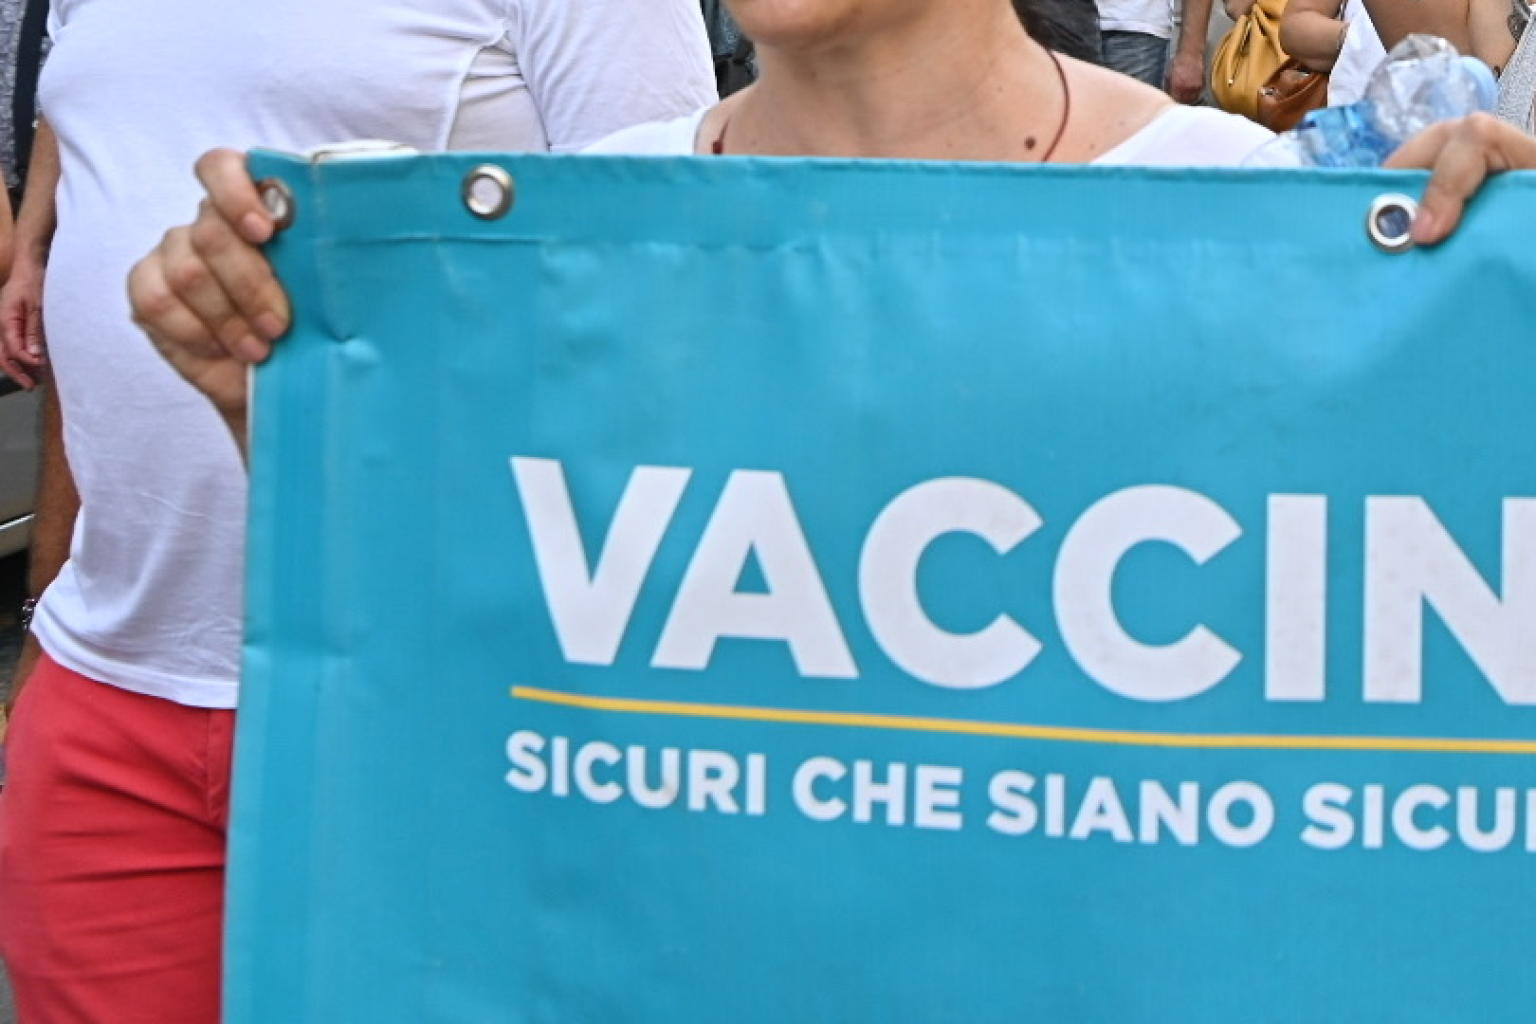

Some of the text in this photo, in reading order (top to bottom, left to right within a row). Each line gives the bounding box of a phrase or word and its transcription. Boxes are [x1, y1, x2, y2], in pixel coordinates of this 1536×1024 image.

[505, 730, 765, 816] SICURI
[792, 757, 963, 830] CHE
[986, 770, 1275, 847] SIANO
